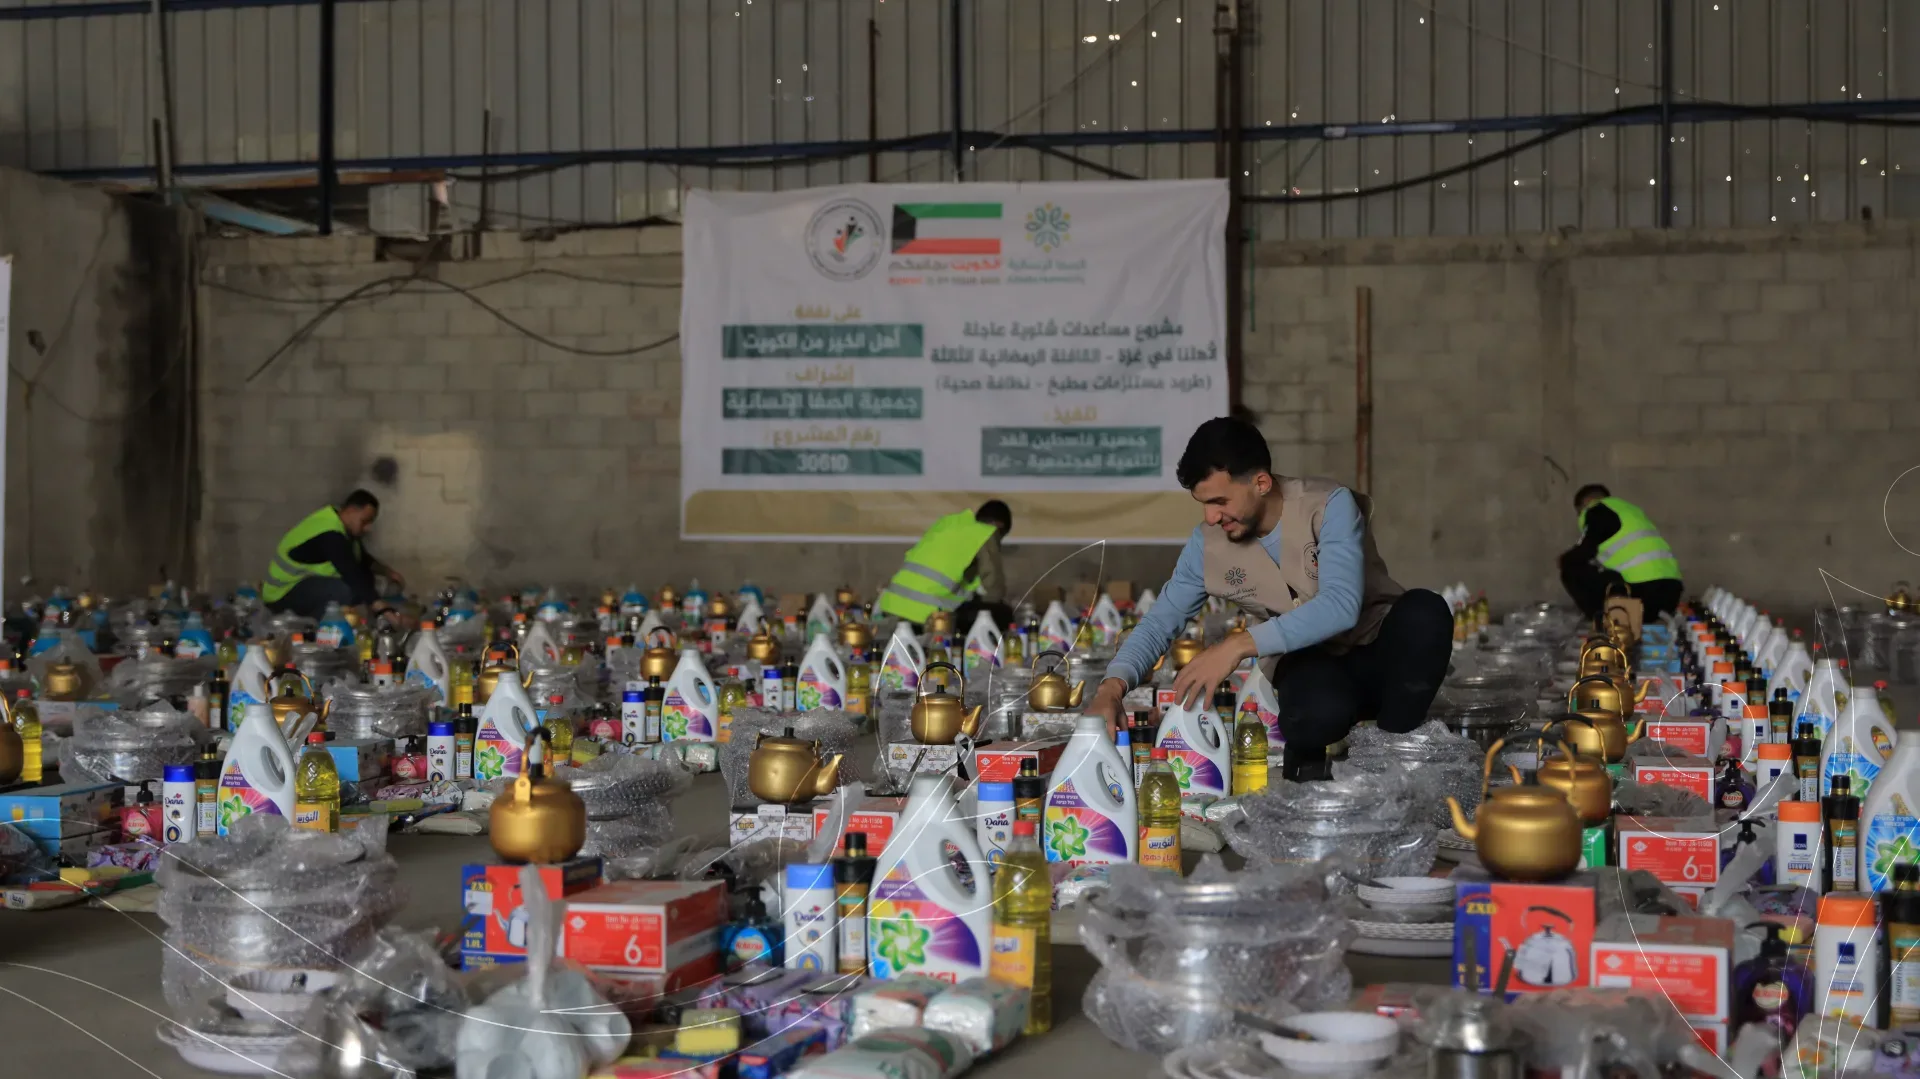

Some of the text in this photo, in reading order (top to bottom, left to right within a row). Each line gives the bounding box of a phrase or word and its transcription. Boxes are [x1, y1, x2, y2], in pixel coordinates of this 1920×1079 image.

[963, 317, 1183, 342] مشروع مساعدات شتوية عاجلة
[742, 328, 900, 355] أهل الخير من الكويت
[1118, 345, 1143, 365] غزة
[1148, 347, 1174, 369] في
[1048, 374, 1089, 396] مطبخ
[807, 391, 854, 410] الصفا
[858, 393, 918, 415] جمعية
[852, 427, 881, 448] رقم
[164, 797, 185, 807] Dana
[985, 816, 1010, 829] Dana
[1683, 855, 1698, 880] 6
[793, 909, 825, 926] Dana
[624, 934, 642, 965] 6
